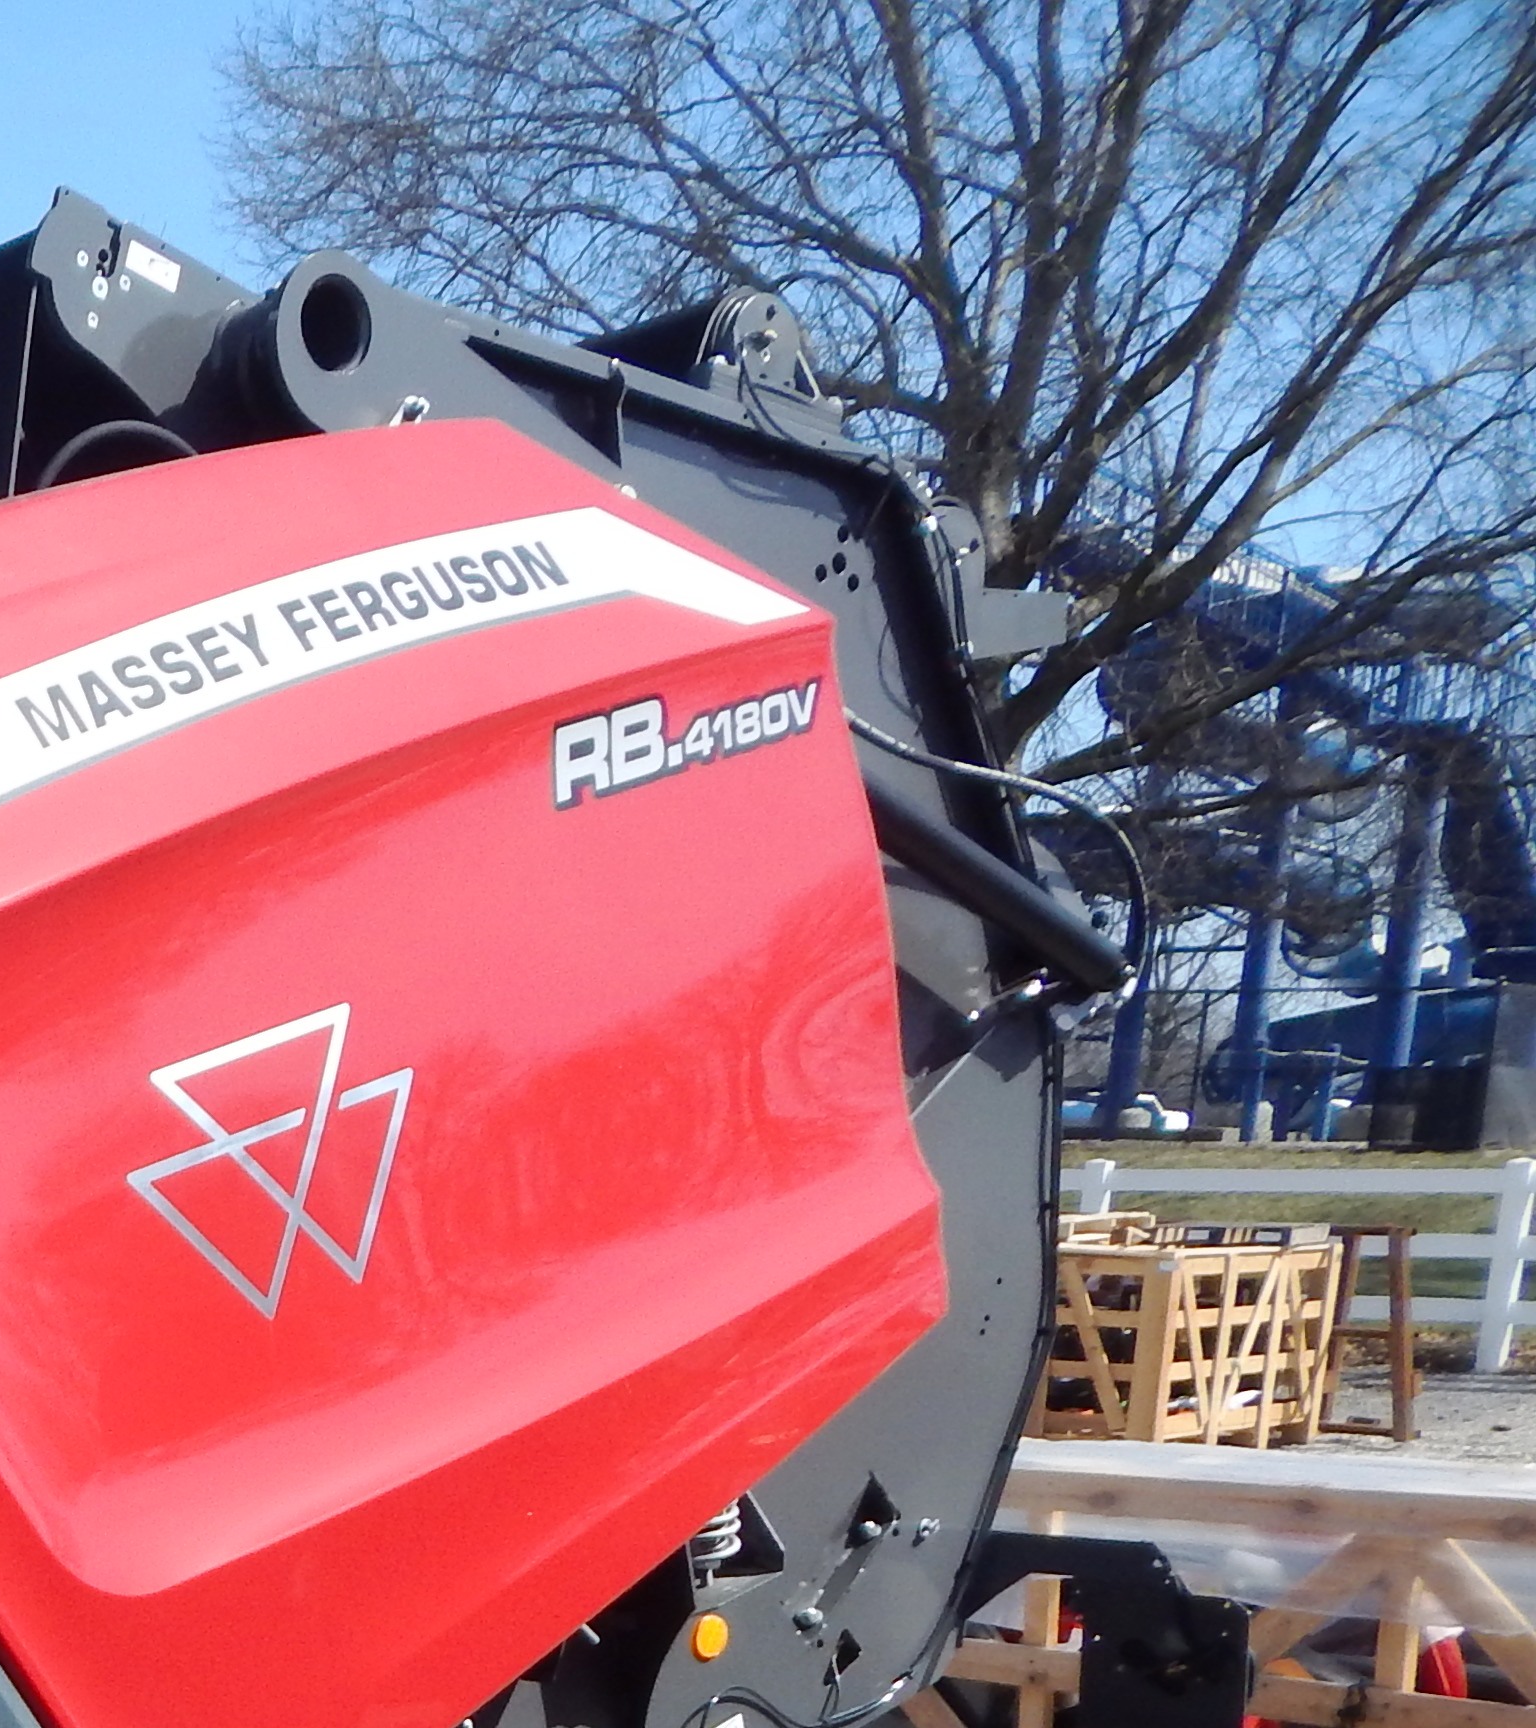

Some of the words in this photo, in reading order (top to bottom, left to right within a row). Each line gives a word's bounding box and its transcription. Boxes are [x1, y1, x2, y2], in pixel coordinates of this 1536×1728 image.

[14, 612, 271, 749] MASSEY
[277, 540, 571, 653] FERGUSON
[554, 679, 820, 807] RB.4180V
